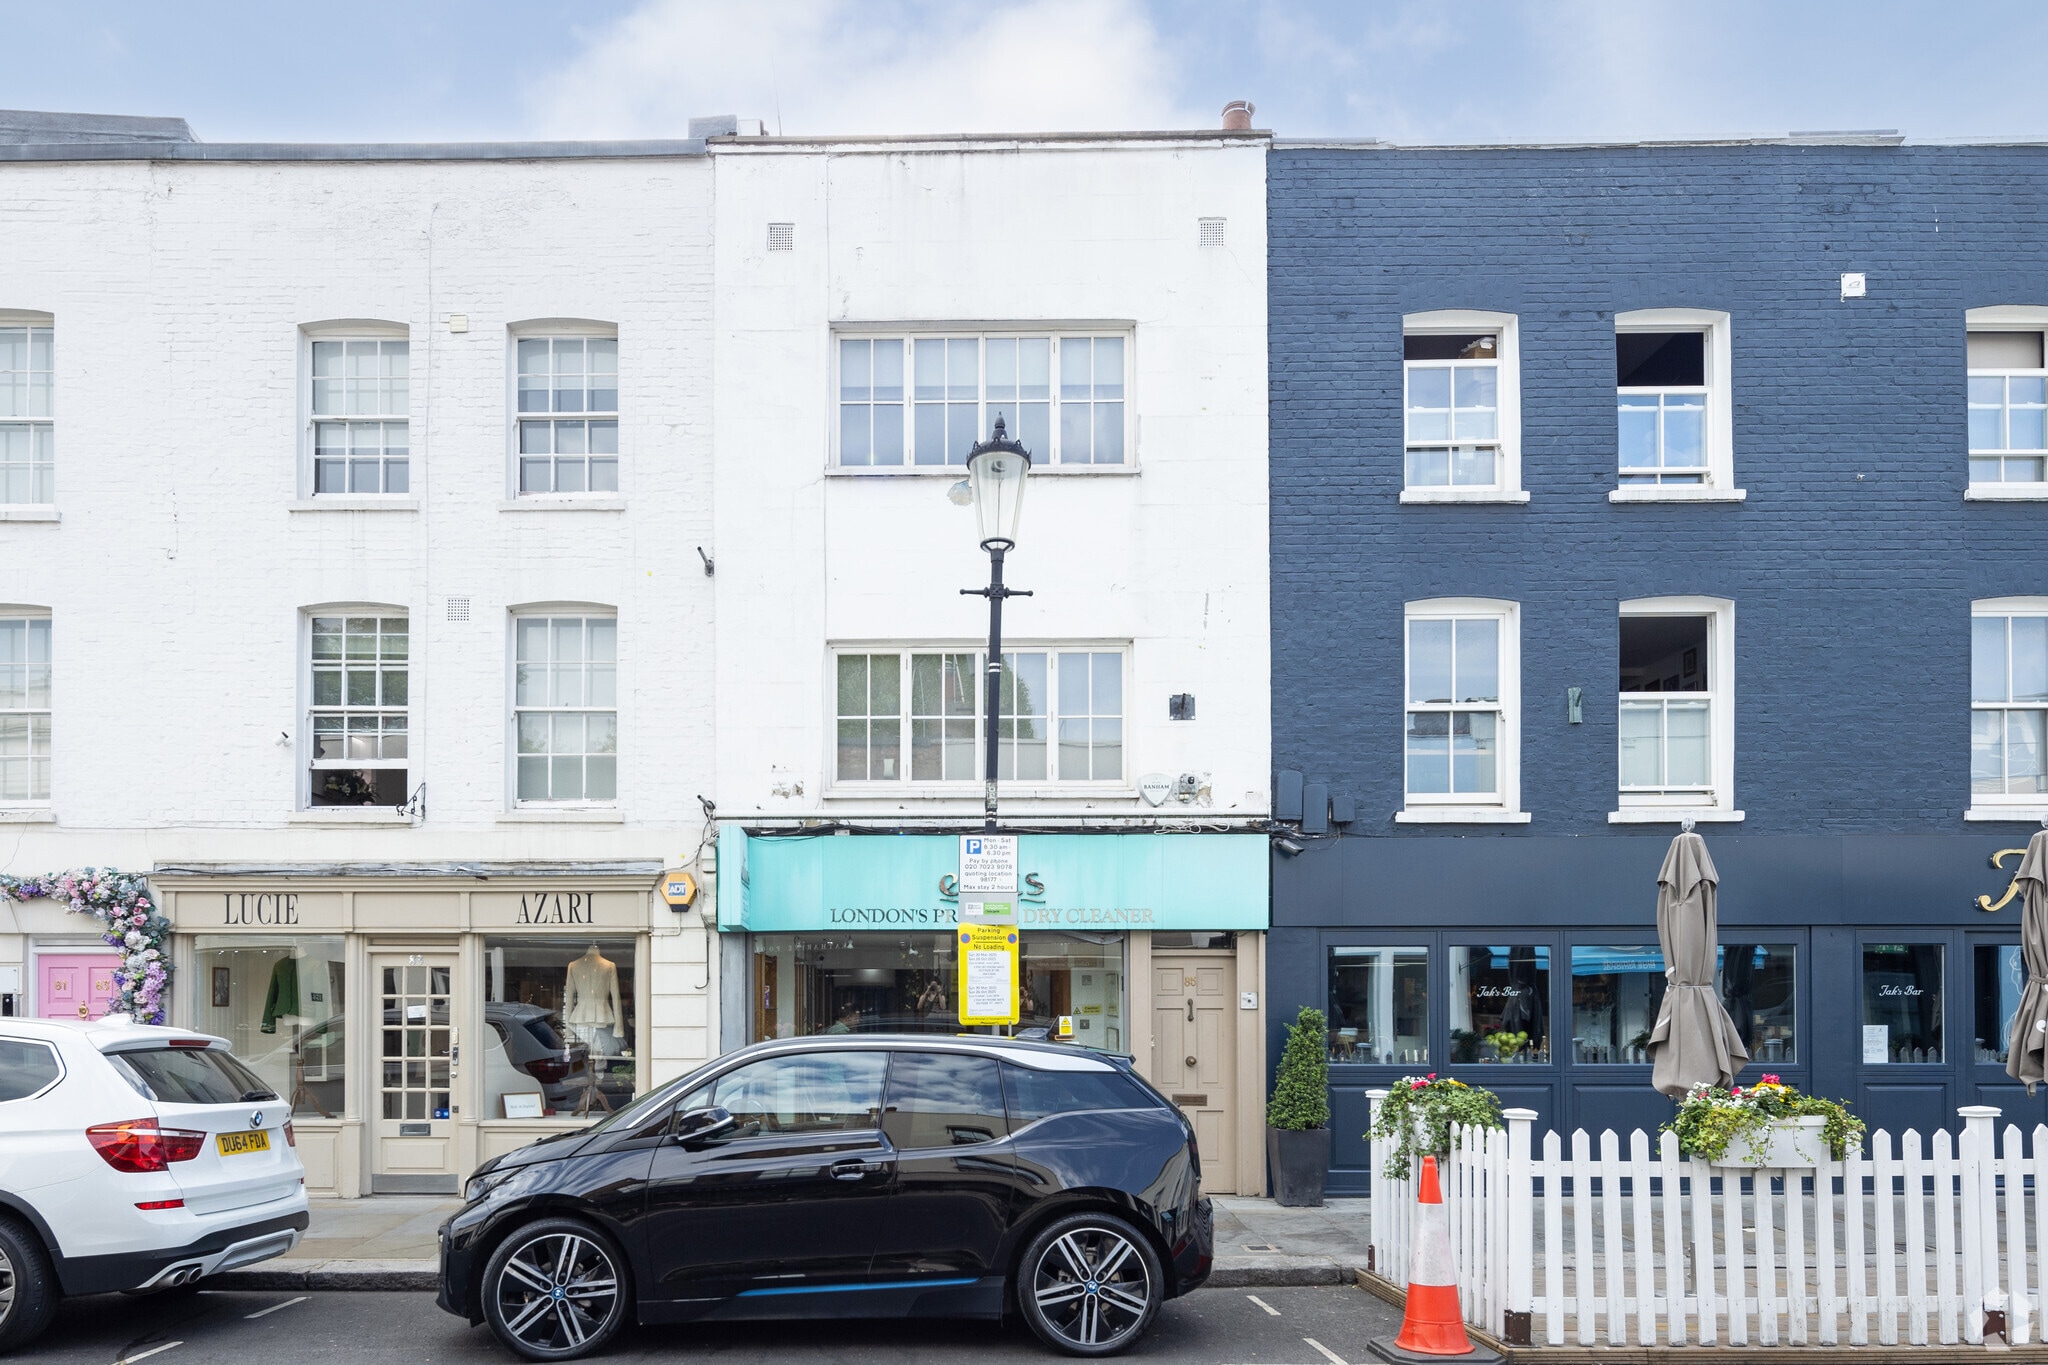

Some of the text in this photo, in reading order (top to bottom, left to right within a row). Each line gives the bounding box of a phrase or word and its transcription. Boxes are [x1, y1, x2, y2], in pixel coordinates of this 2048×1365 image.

[668, 884, 686, 895] ADT
[223, 892, 595, 925] LUCIE AZARI
[830, 908, 928, 923] LONDON'S
[1023, 908, 1063, 923] DRY
[1065, 908, 1155, 923] CLEANER
[1184, 976, 1197, 987] 85
[1476, 985, 1522, 998] Jak's Bar
[1878, 984, 1924, 997] Jak's Bar
[221, 1133, 267, 1153] DU64 FDA
